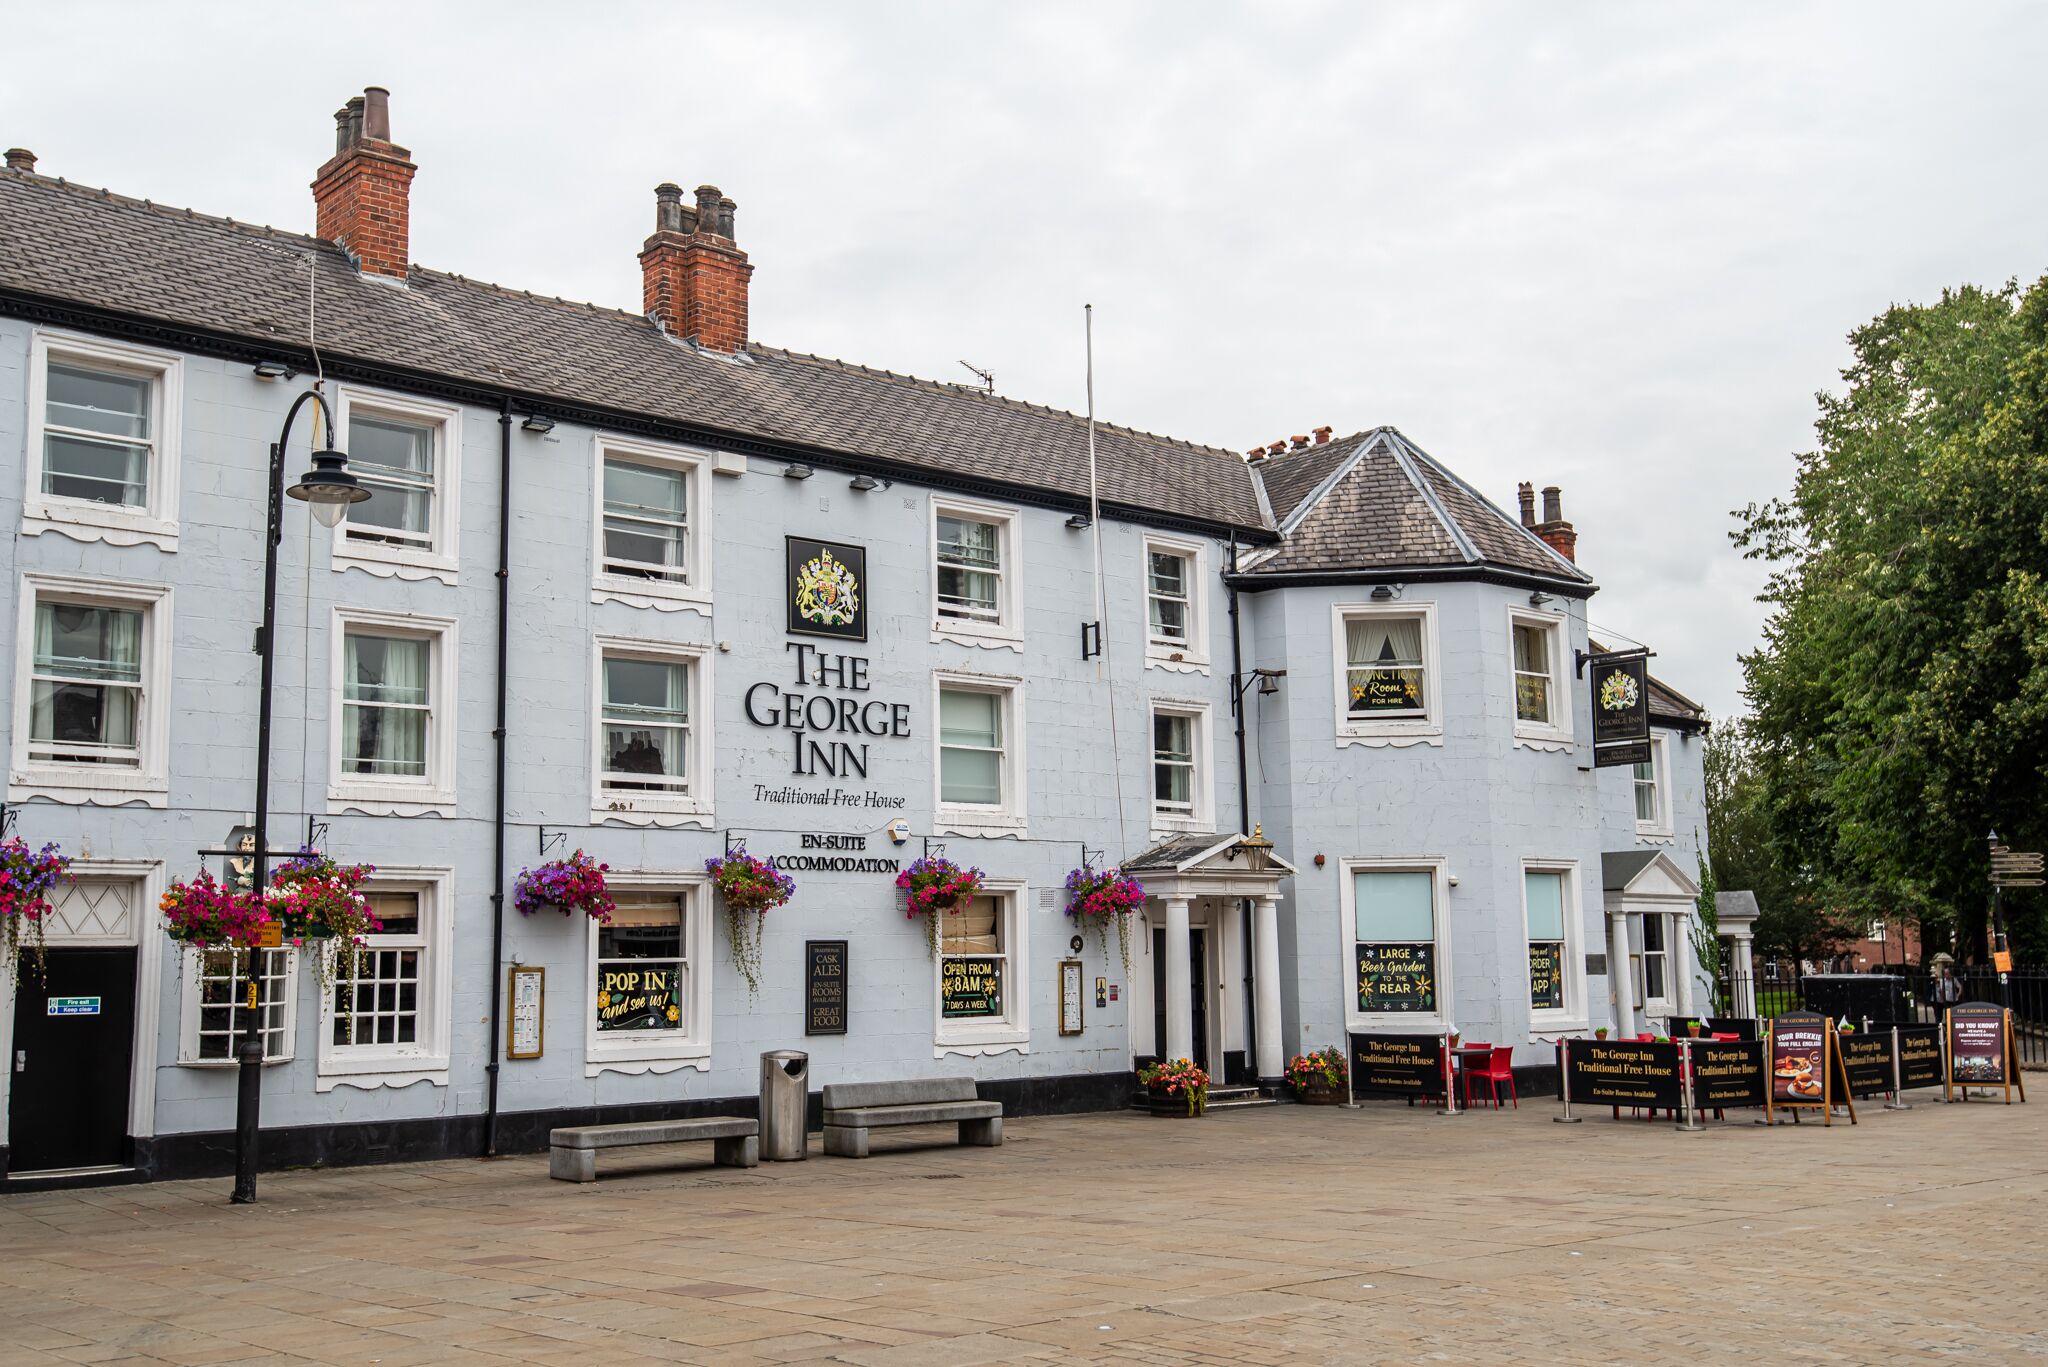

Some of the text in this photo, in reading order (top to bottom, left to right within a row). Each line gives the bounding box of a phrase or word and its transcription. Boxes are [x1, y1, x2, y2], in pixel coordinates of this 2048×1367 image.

[786, 642, 870, 691] THE
[1369, 682, 1402, 696] Room
[744, 682, 910, 738] GEORGE
[792, 730, 870, 779] INN
[754, 784, 904, 809] Traditional Free House
[801, 834, 866, 851] EN-SUITE
[767, 854, 900, 874] ACCOMMODATION
[816, 955, 838, 963] CASK
[1380, 948, 1410, 959] LARGE
[814, 965, 840, 976] ALES
[944, 963, 992, 975] OPEN FROM
[1360, 960, 1426, 975] Beer Garden
[605, 972, 666, 991] POP IN
[955, 976, 980, 991] 8AM
[1532, 980, 1549, 993] APP
[812, 988, 841, 996] ROOMS
[1380, 984, 1410, 994] REAR
[602, 992, 669, 1019] and see us!
[813, 1008, 840, 1016] GREAT
[813, 1016, 839, 1026] FOOD
[1777, 1032, 1822, 1041] YOUR BREKKIE
[1369, 1041, 1420, 1053] The George Inn
[1358, 1053, 1434, 1066] Traditional Free House
[1592, 1049, 1654, 1062] The George Inn
[1707, 1050, 1748, 1062] The George Inn
[1577, 1061, 1671, 1076] Traditional Free House
[1697, 1064, 1757, 1076] Traditional Free House
